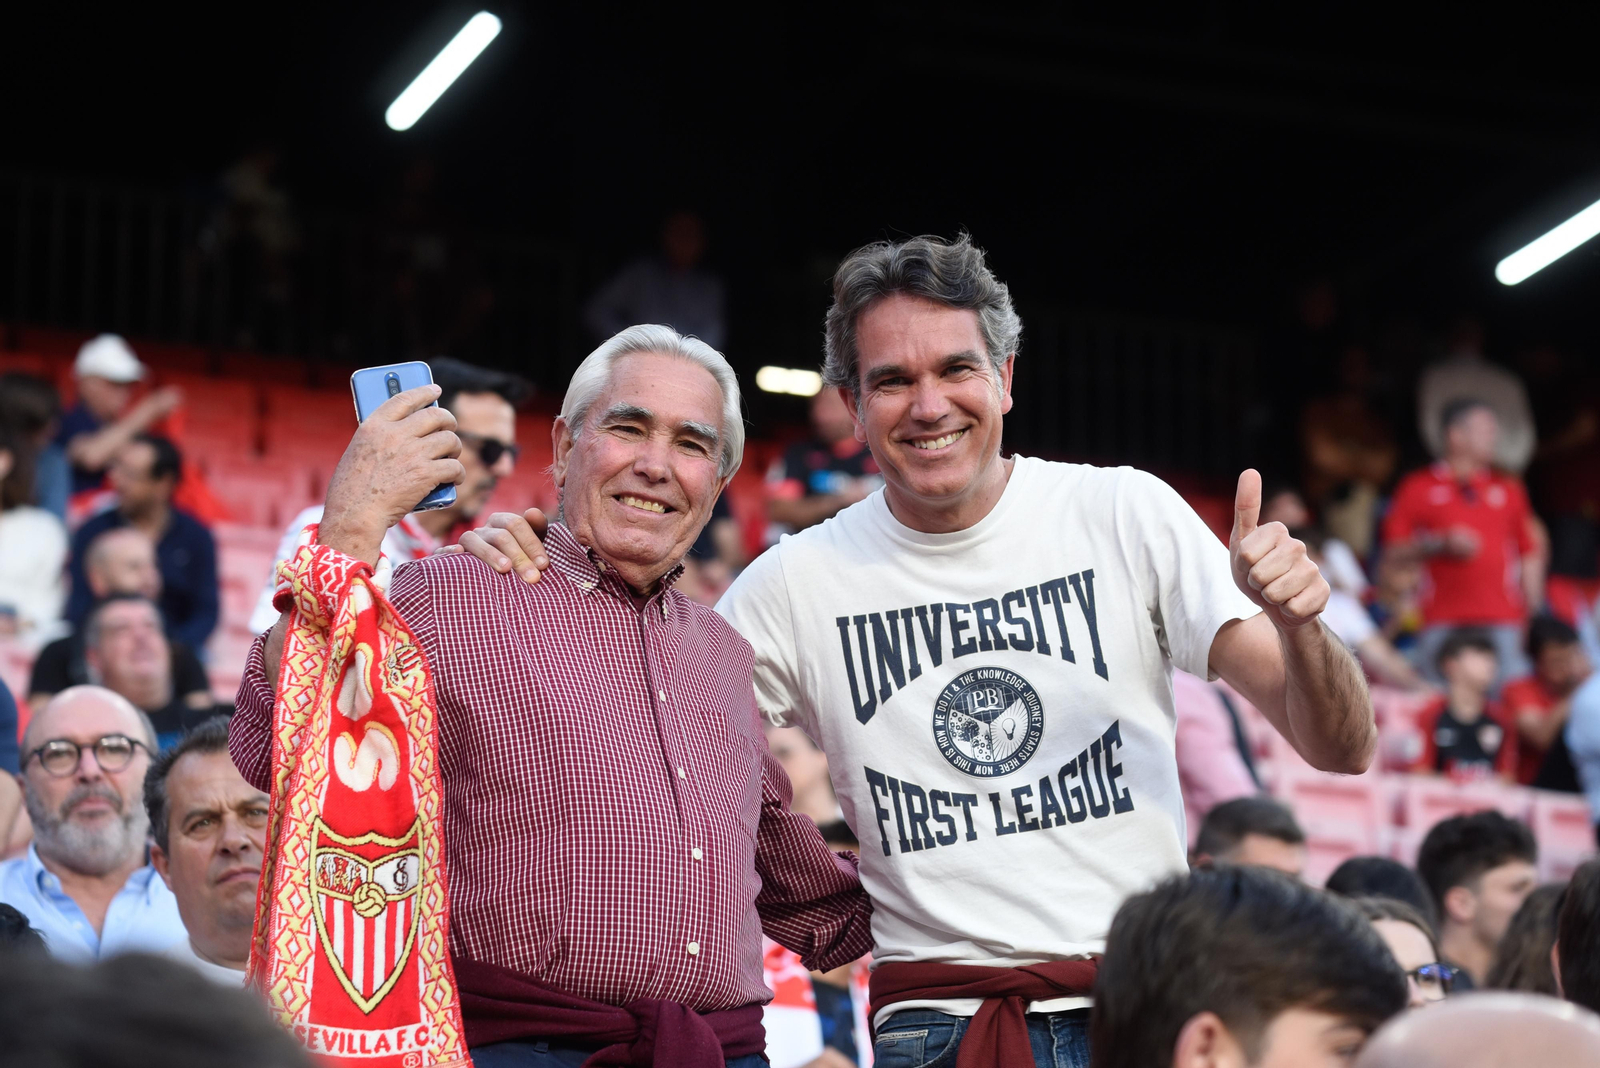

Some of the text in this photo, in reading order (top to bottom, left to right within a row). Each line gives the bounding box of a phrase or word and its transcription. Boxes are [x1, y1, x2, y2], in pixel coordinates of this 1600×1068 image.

[836, 568, 1109, 726] UNIVERSITY
[972, 688, 999, 708] PB
[935, 669, 1042, 775] NOW THIS IS HOW WE DO IT & THE KNOWLEDGE JOURNEY STARTS HERE
[863, 719, 1135, 857] FIRST LEAGUE
[294, 1027, 393, 1054] SEVILLA
